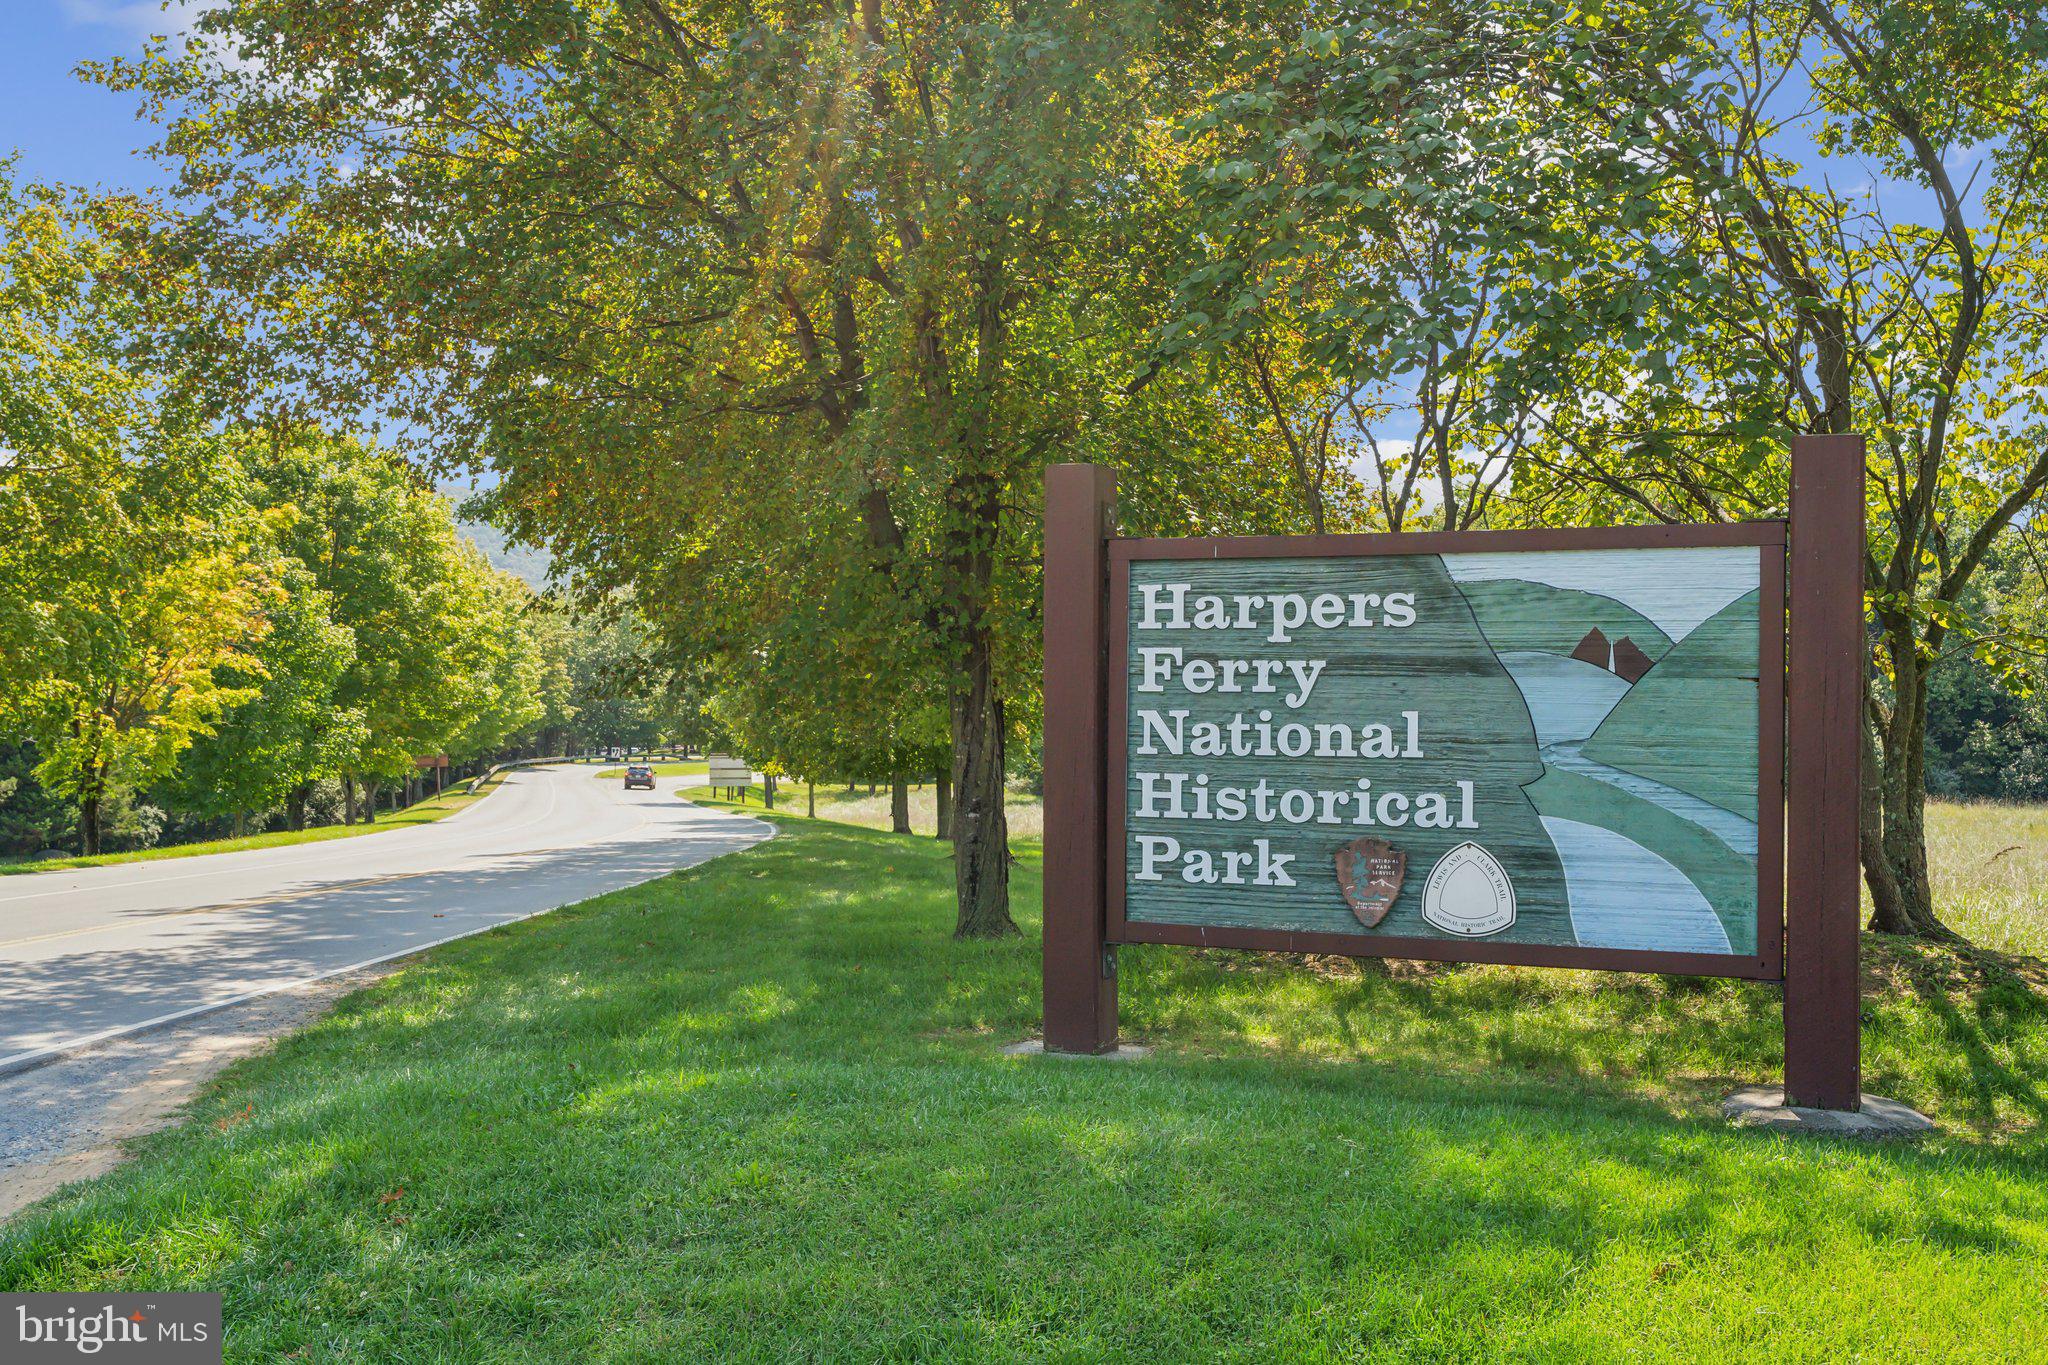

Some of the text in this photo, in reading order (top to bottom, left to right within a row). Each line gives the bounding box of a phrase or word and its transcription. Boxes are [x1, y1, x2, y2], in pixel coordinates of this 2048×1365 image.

[1137, 583, 1417, 643] Harpers
[1137, 647, 1326, 709] Ferry
[1136, 709, 1424, 758] National
[1134, 772, 1479, 829] Historical
[1134, 835, 1297, 887] Park
[1432, 854, 1462, 890] LEWIS AND
[1476, 855, 1507, 901] CLARK TRAIL
[1433, 911, 1459, 927] NATIONAL
[1489, 915, 1506, 925] TRAIL
